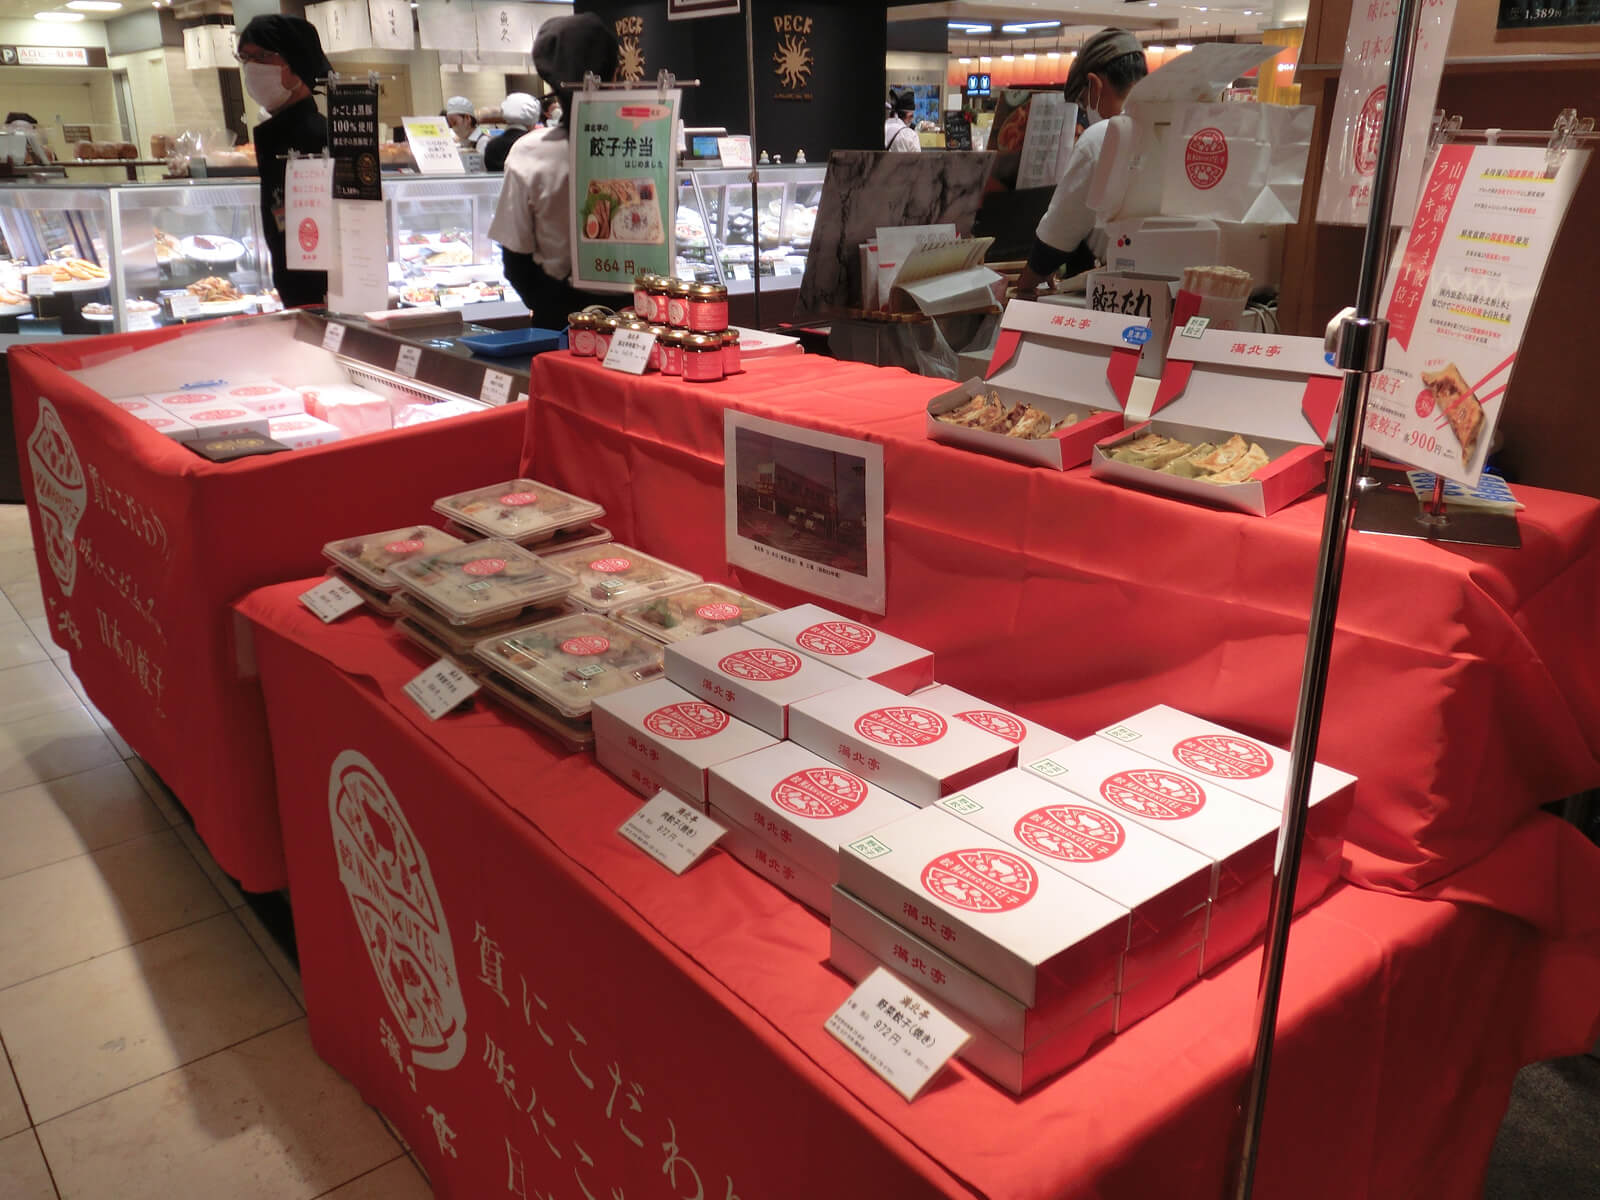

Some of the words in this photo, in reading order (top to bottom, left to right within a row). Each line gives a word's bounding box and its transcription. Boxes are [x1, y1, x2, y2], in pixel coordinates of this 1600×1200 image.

[616, 16, 644, 36] PECK
[773, 15, 814, 35] PECK
[332, 104, 374, 116] かごしま黒豚
[333, 120, 374, 133] 100%使用
[590, 136, 654, 157] 餃子弁当
[625, 160, 664, 169] はじめました
[1408, 162, 1463, 308] 山梨激うま餃子
[951, 863, 1010, 899] MANHOKUTEI
[873, 1019, 902, 1046] 972円
